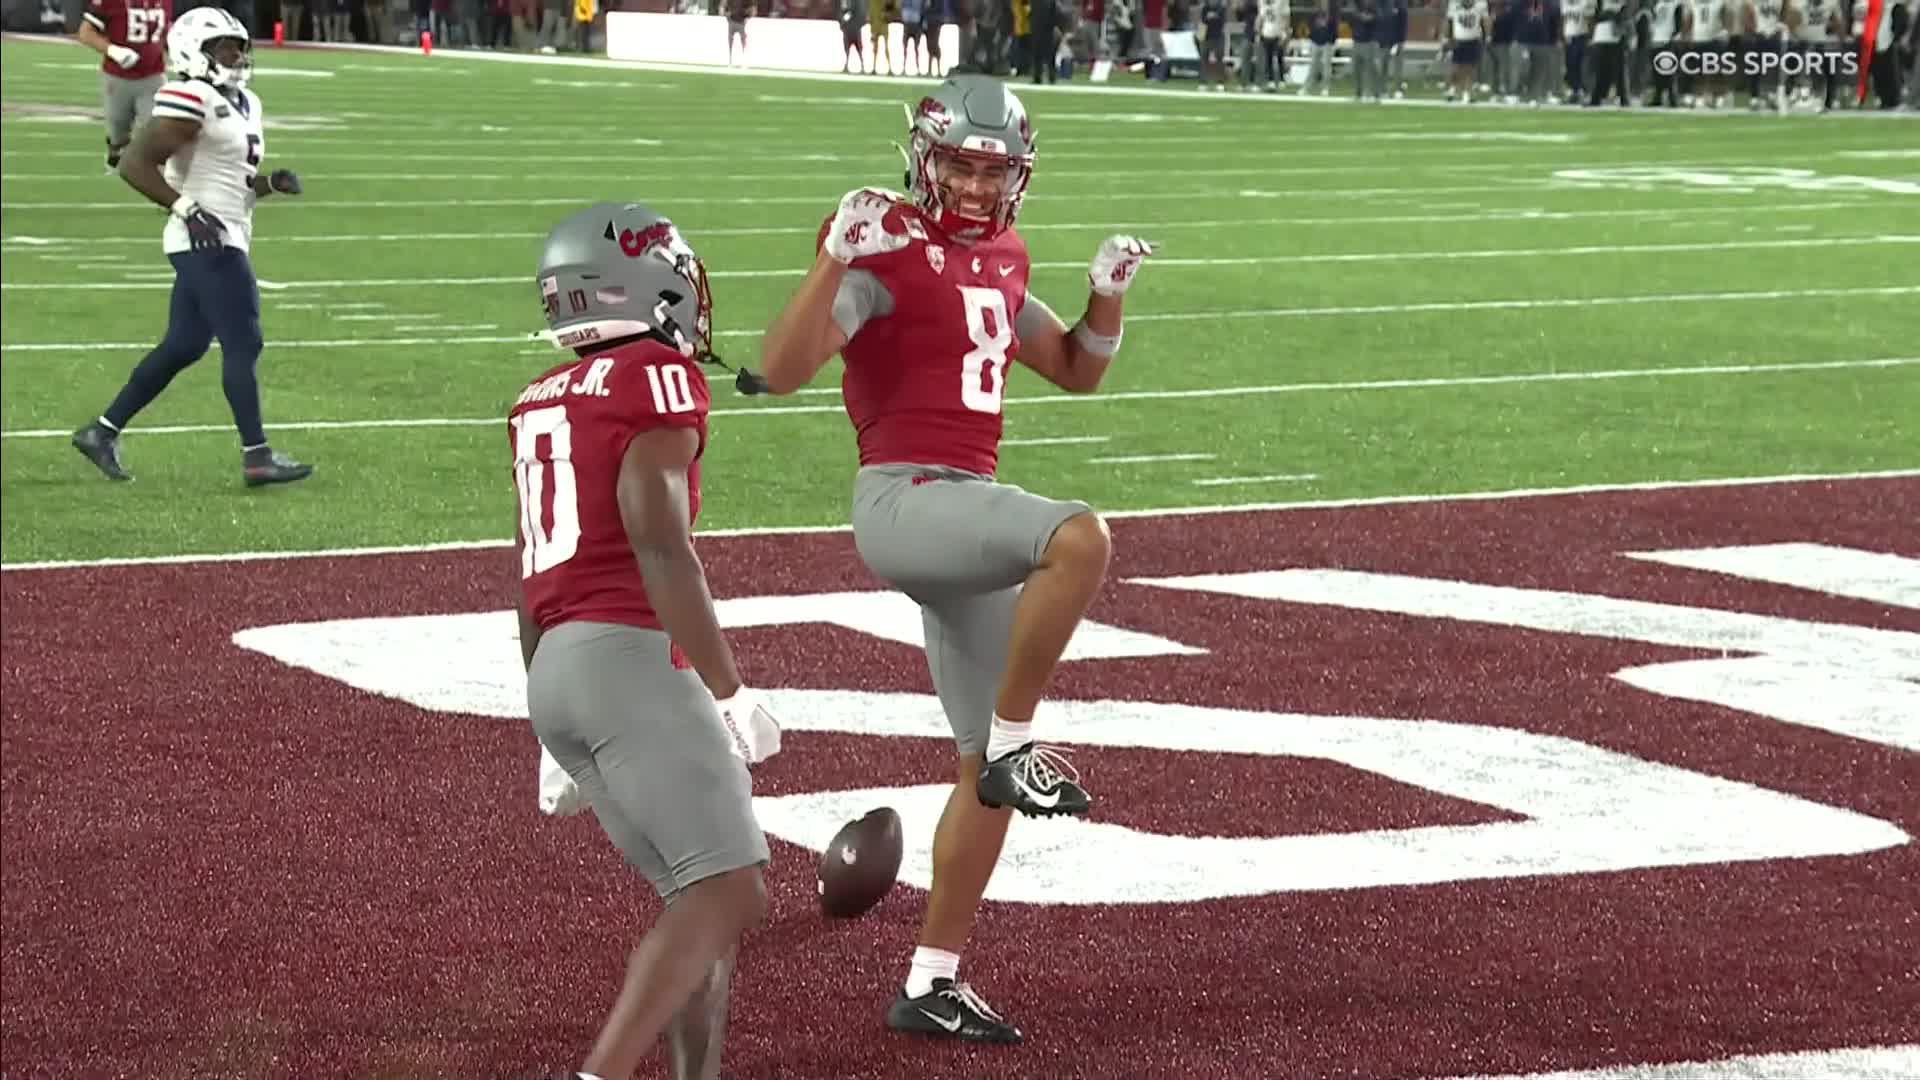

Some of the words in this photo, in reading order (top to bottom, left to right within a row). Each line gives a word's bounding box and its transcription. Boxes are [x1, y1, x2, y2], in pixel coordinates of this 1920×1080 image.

[127, 8, 165, 43] 67
[246, 133, 260, 189] 5
[568, 288, 587, 313] 10
[956, 285, 1012, 415] 8
[644, 364, 696, 414] 10
[510, 404, 582, 580] 10
